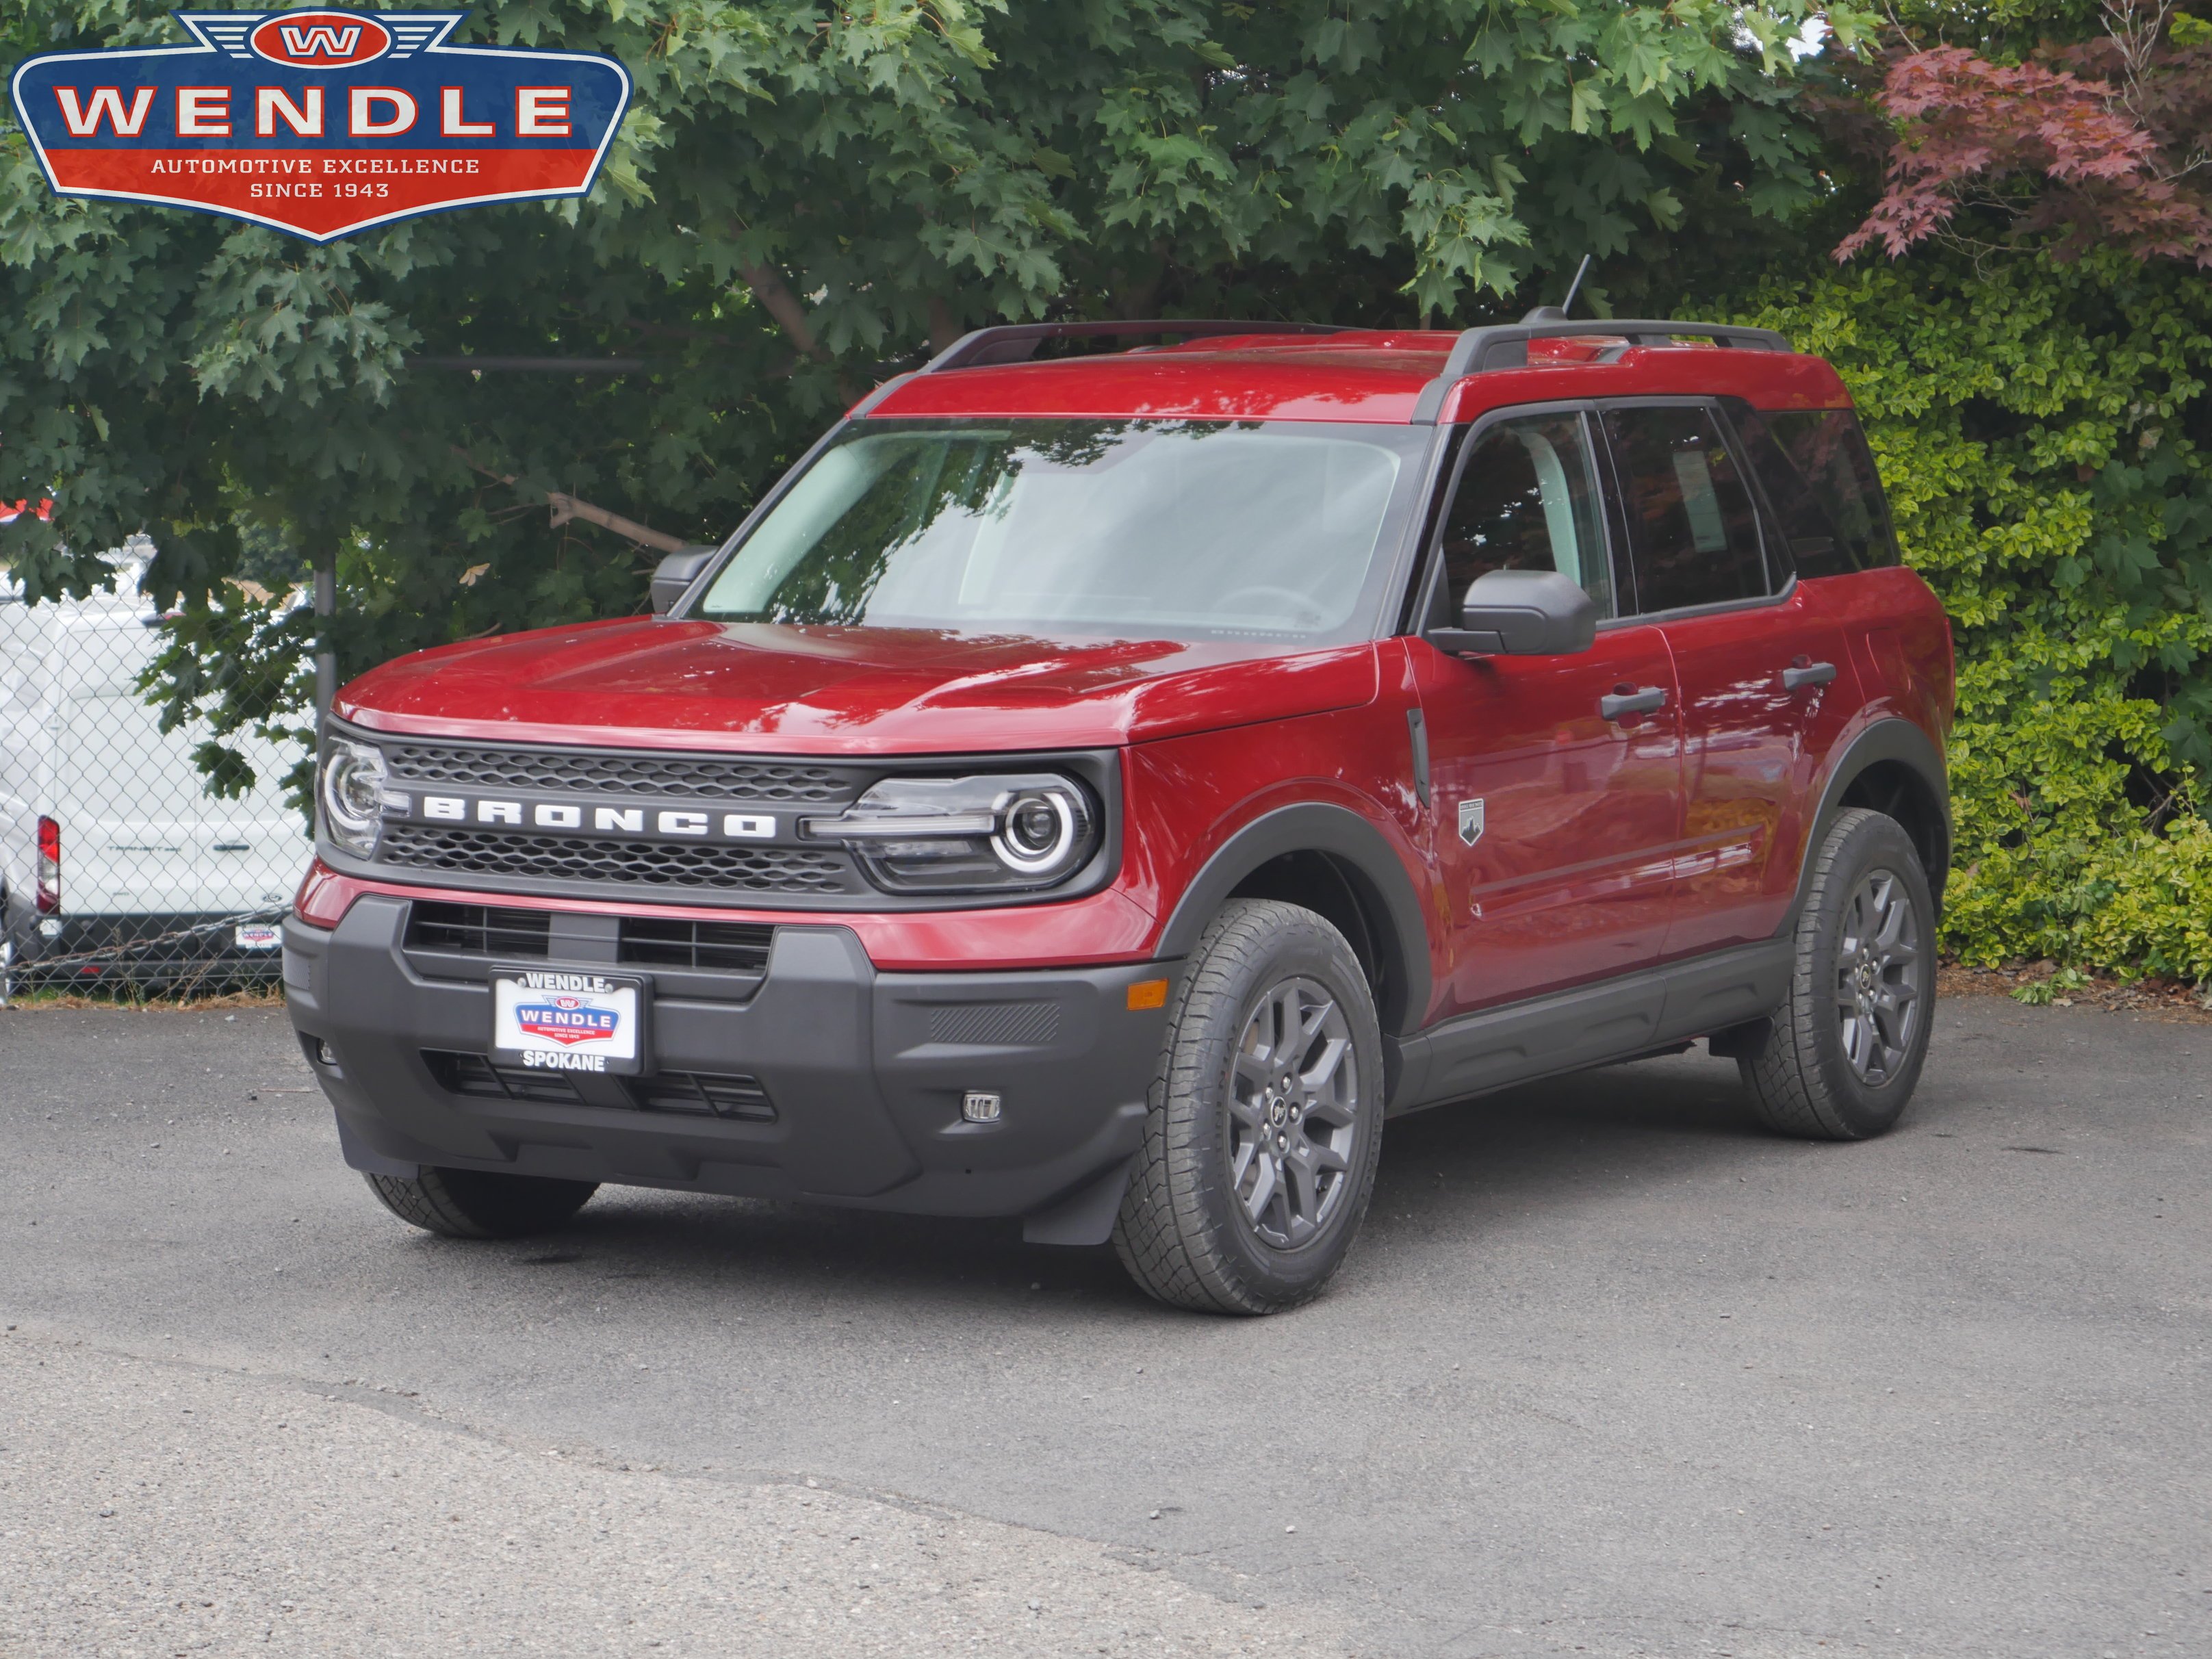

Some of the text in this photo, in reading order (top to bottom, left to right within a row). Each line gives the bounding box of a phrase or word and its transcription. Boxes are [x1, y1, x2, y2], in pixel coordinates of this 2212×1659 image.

[424, 796, 776, 838] BRONCO
[526, 973, 605, 992] WENDLE
[521, 1009, 611, 1028] WENDLE
[523, 1050, 604, 1072] SPOKANE
